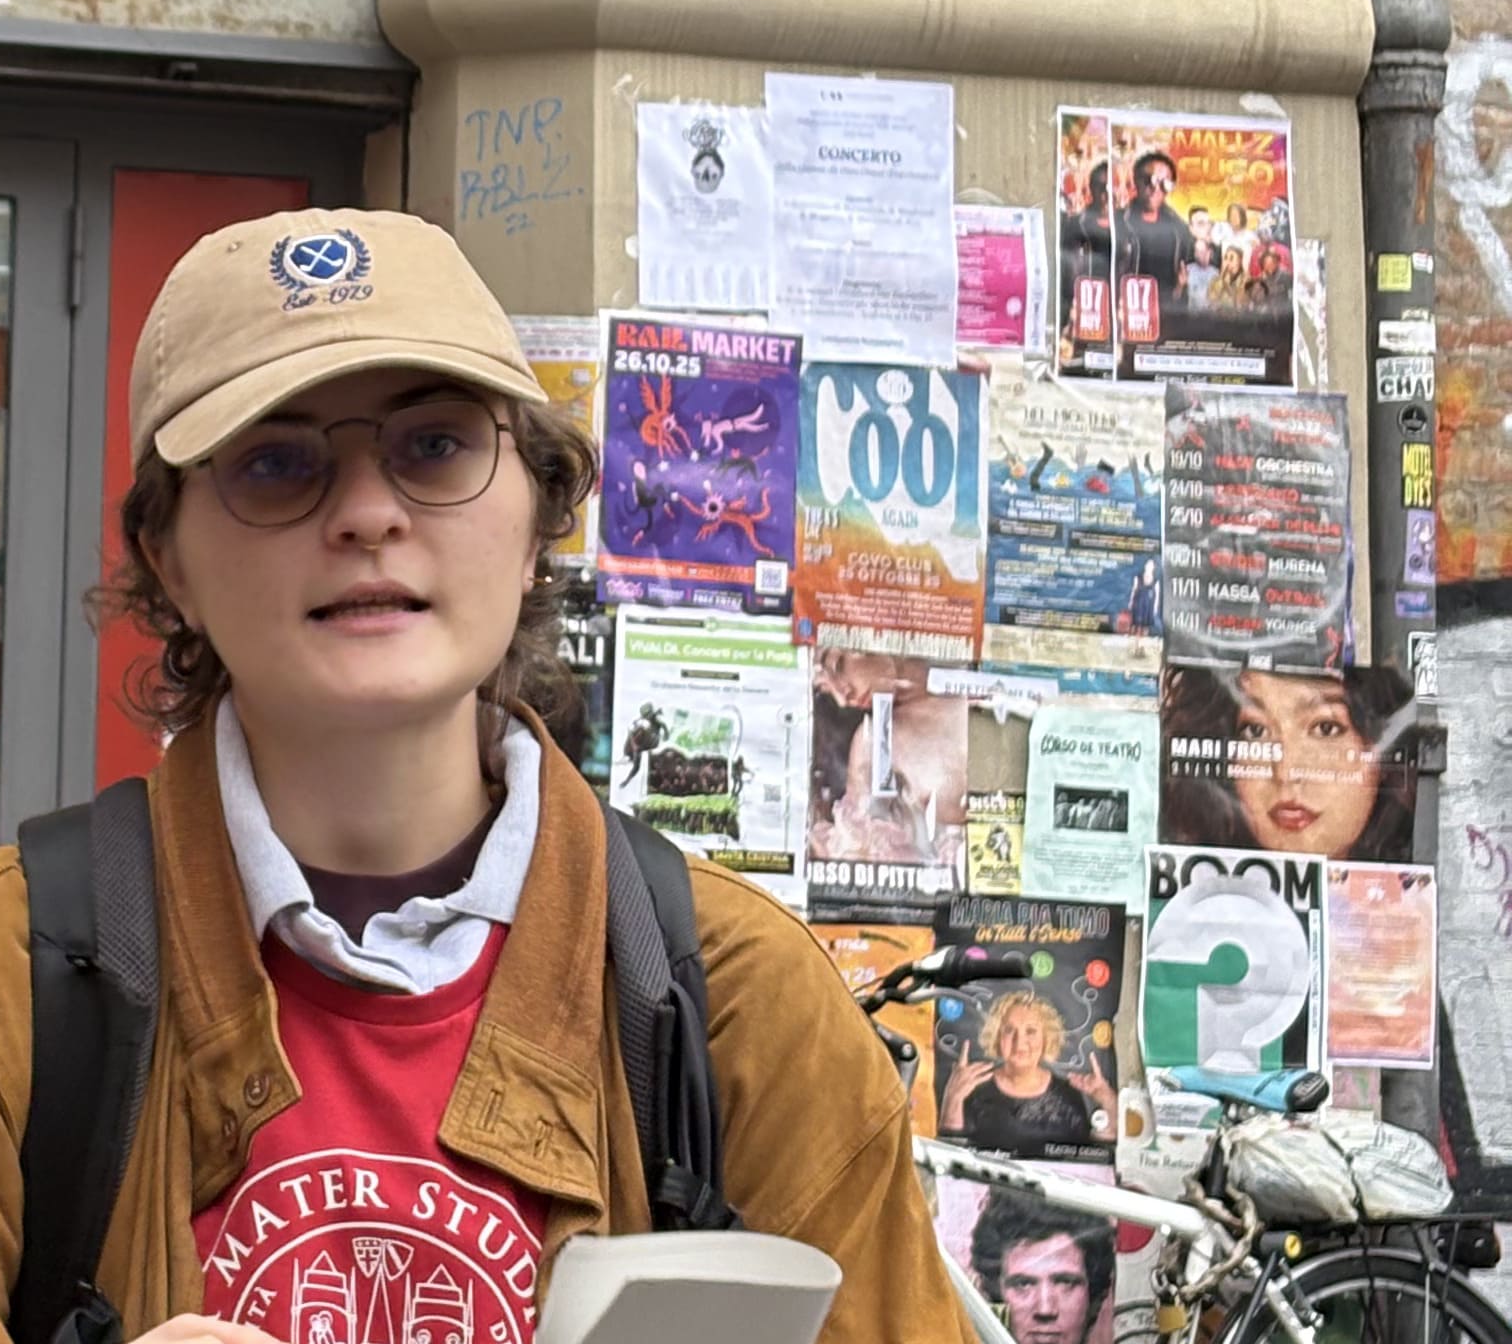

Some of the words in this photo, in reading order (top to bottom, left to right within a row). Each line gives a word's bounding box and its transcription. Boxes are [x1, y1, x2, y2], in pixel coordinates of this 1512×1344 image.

[818, 145, 902, 164] CONCERTO
[329, 284, 373, 305] 1979
[1126, 279, 1152, 308] 07
[692, 331, 795, 363] MARKET
[614, 350, 701, 377] 26.10.25
[1097, 741, 1142, 762] TEATRO
[1171, 737, 1221, 758] MARI
[1227, 740, 1283, 761] FROES
[1150, 852, 1320, 910] BOOM
[212, 1168, 389, 1287] MATER
